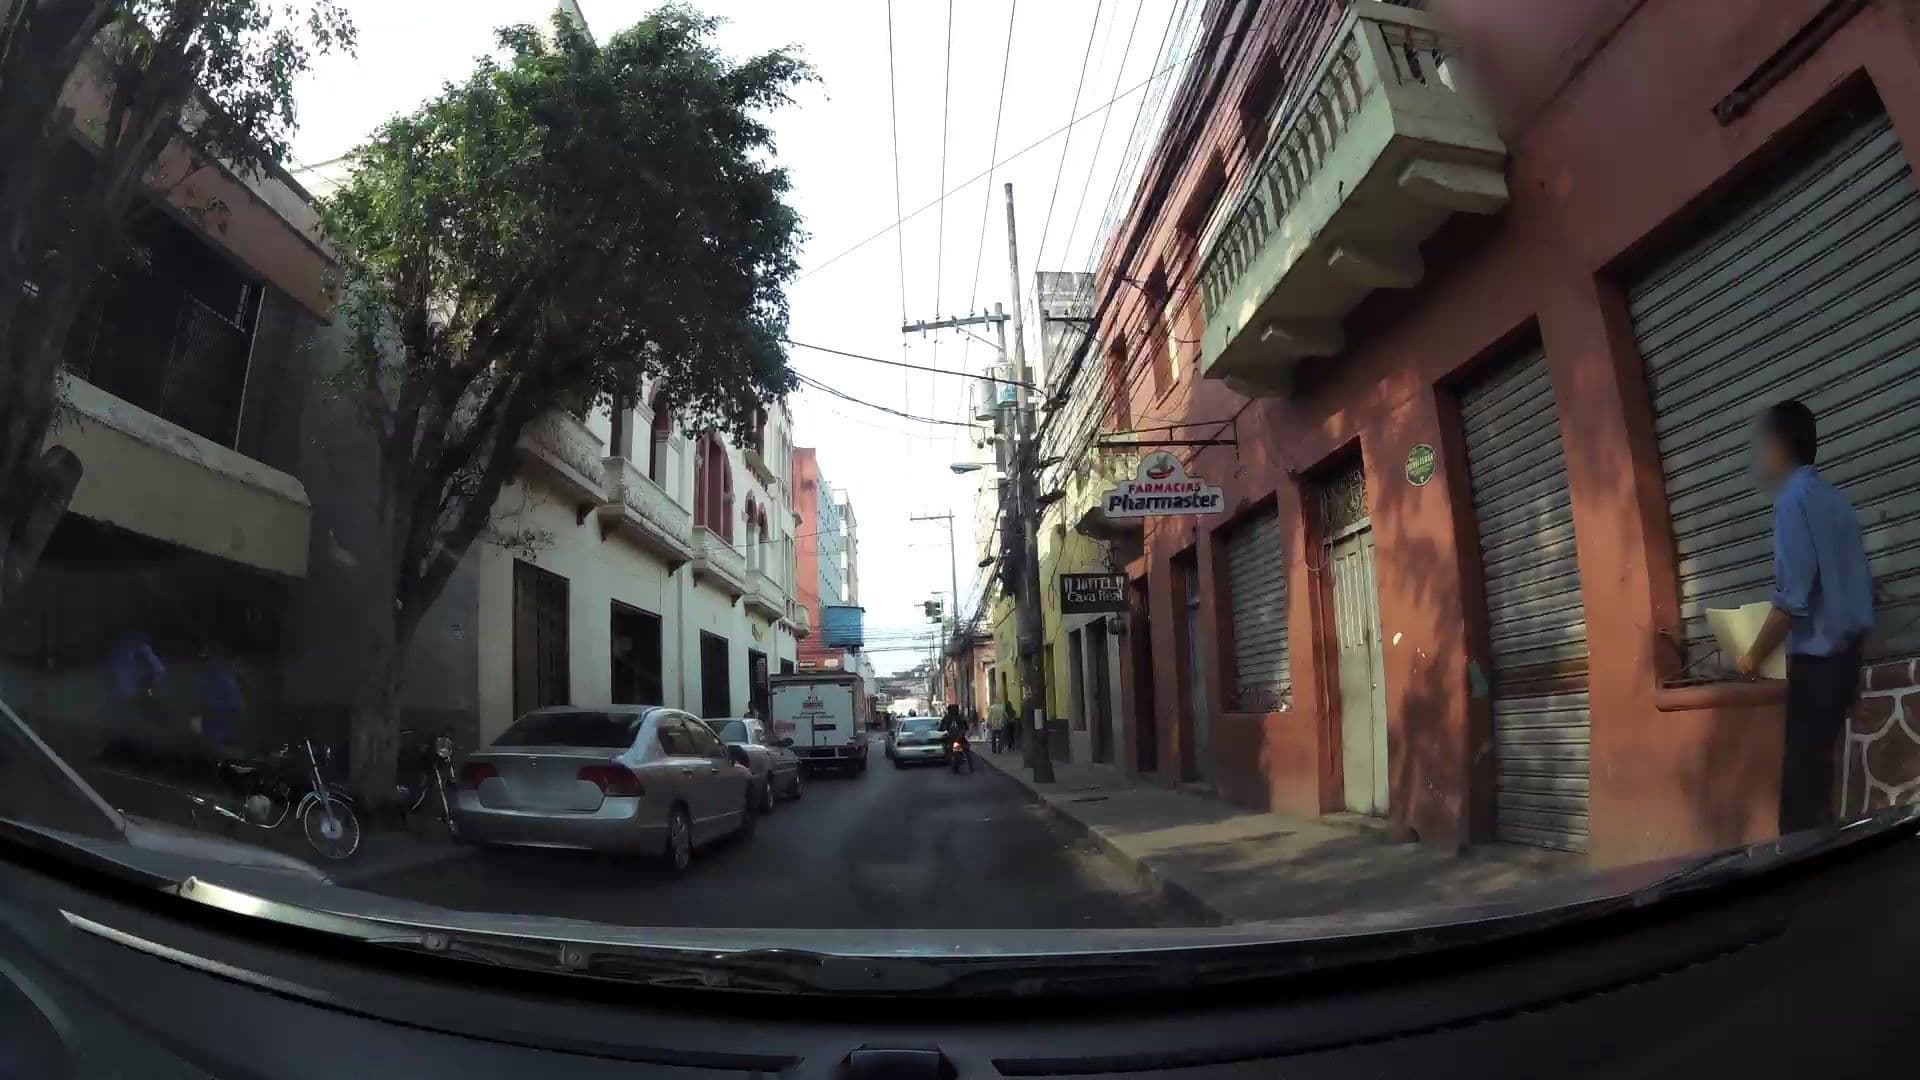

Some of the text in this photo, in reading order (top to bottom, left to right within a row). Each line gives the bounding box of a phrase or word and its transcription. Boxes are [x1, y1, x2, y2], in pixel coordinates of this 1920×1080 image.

[1128, 482, 1201, 494] FARMACIAS
[1109, 494, 1220, 512] Pharmaster
[1099, 588, 1123, 601] Real
